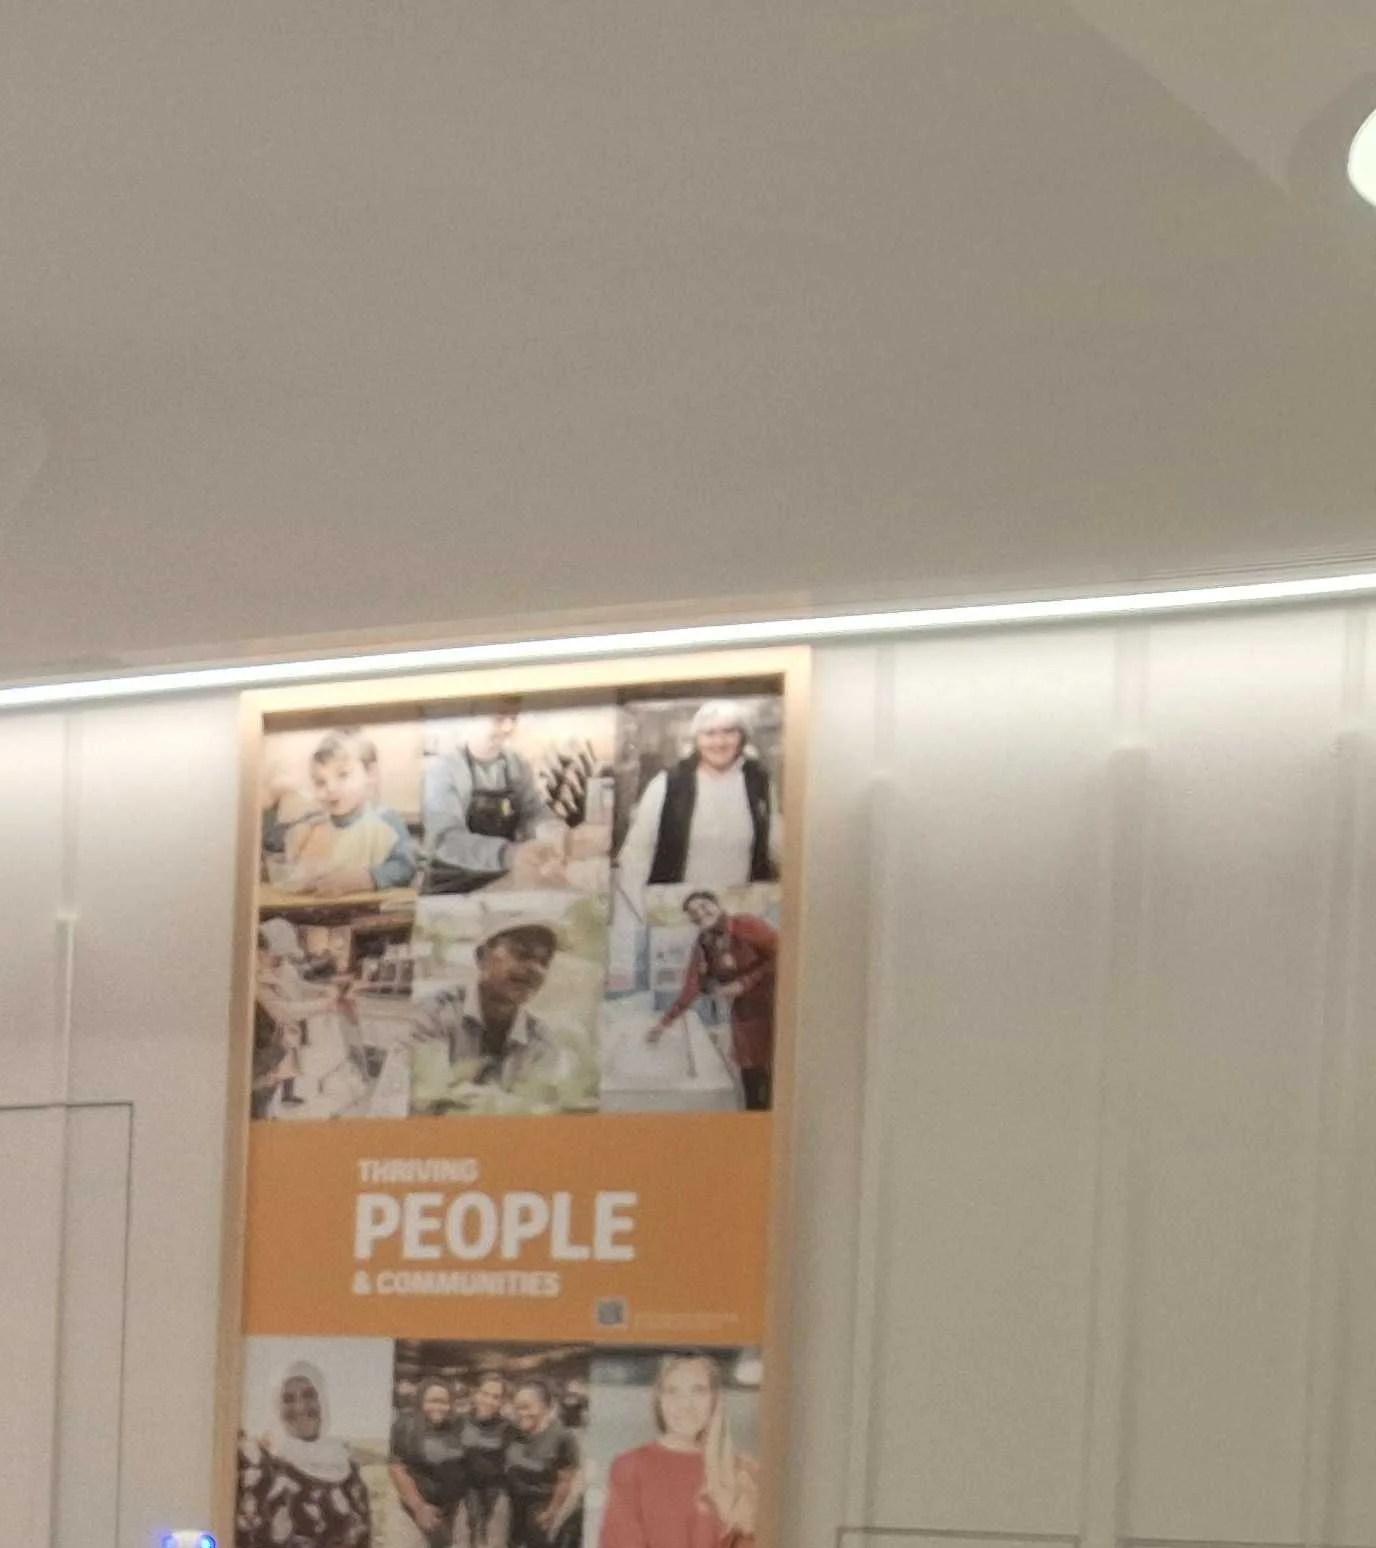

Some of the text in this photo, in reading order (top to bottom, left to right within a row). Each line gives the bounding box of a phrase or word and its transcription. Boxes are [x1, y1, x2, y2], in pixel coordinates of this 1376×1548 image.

[357, 1158, 480, 1185] THRIVING
[352, 1190, 638, 1262] PEOPLE
[351, 1270, 562, 1298] & COMMUNITIES
